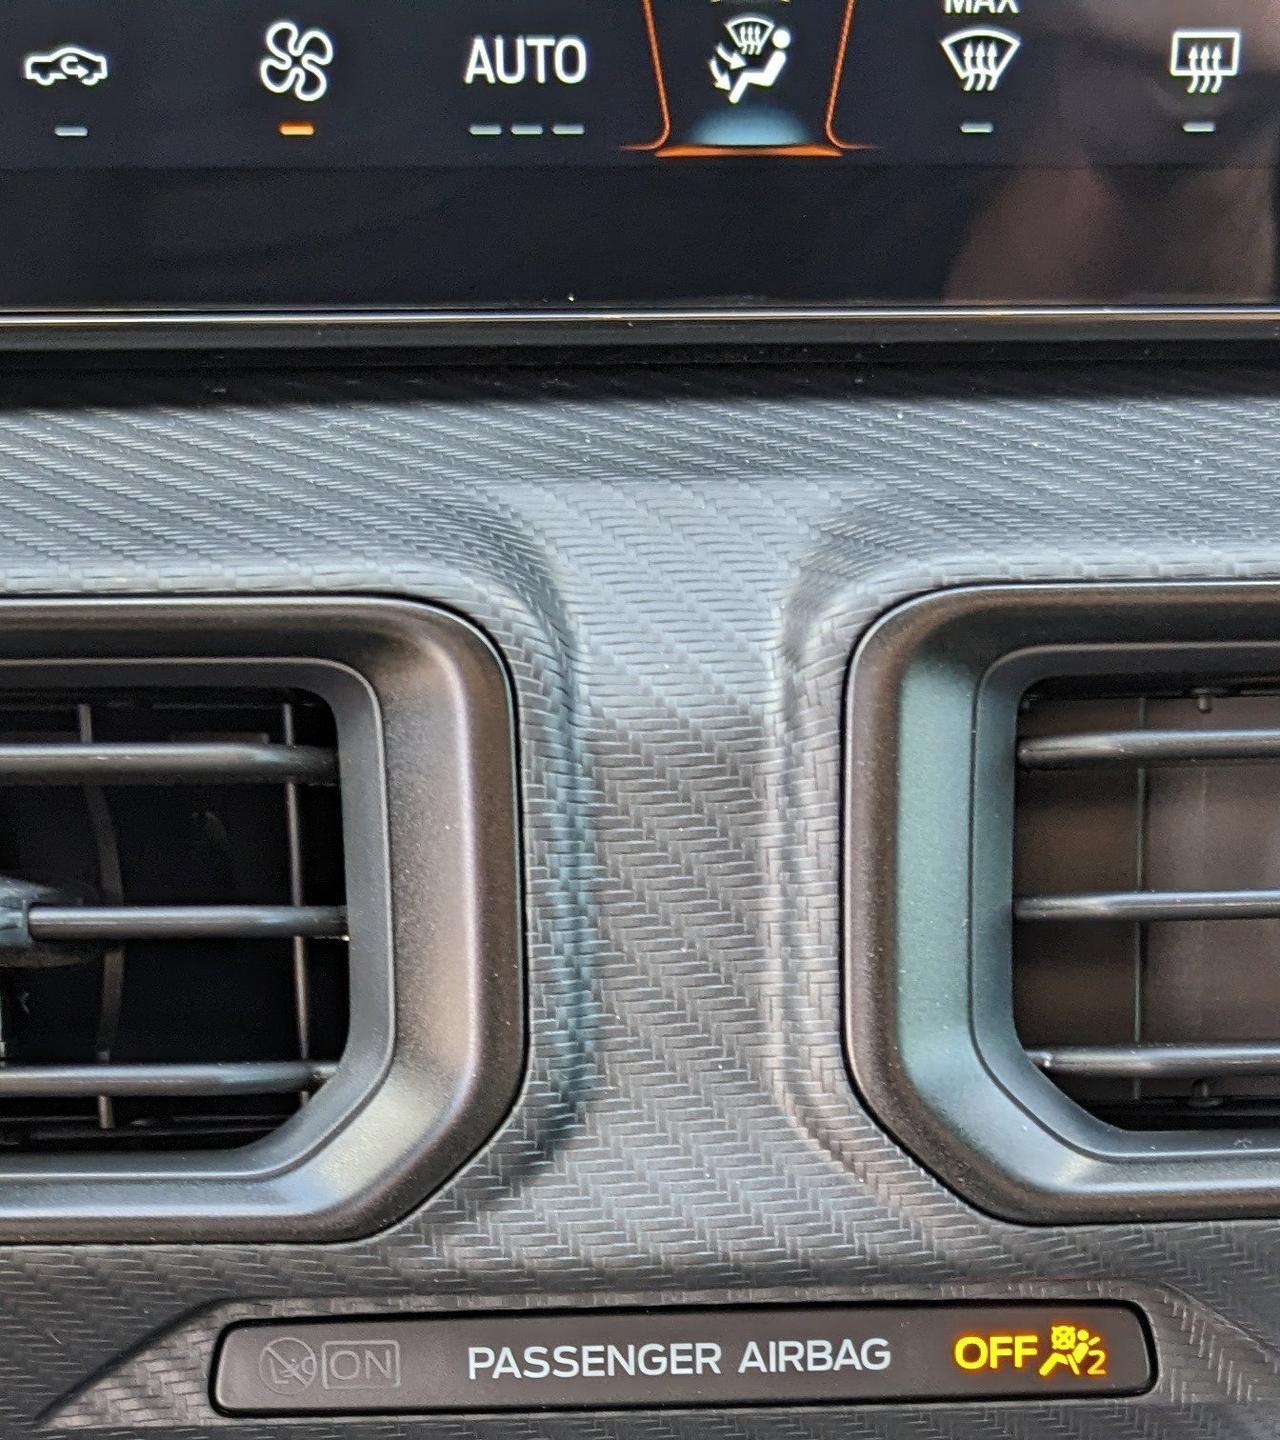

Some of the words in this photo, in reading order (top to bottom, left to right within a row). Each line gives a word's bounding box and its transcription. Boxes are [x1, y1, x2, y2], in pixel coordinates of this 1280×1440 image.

[465, 36, 587, 83] AUTO
[328, 1348, 391, 1380] ON
[469, 1343, 721, 1379] PASSENGER
[738, 1338, 890, 1373] AIRBAG
[955, 1335, 1037, 1369] OFF
